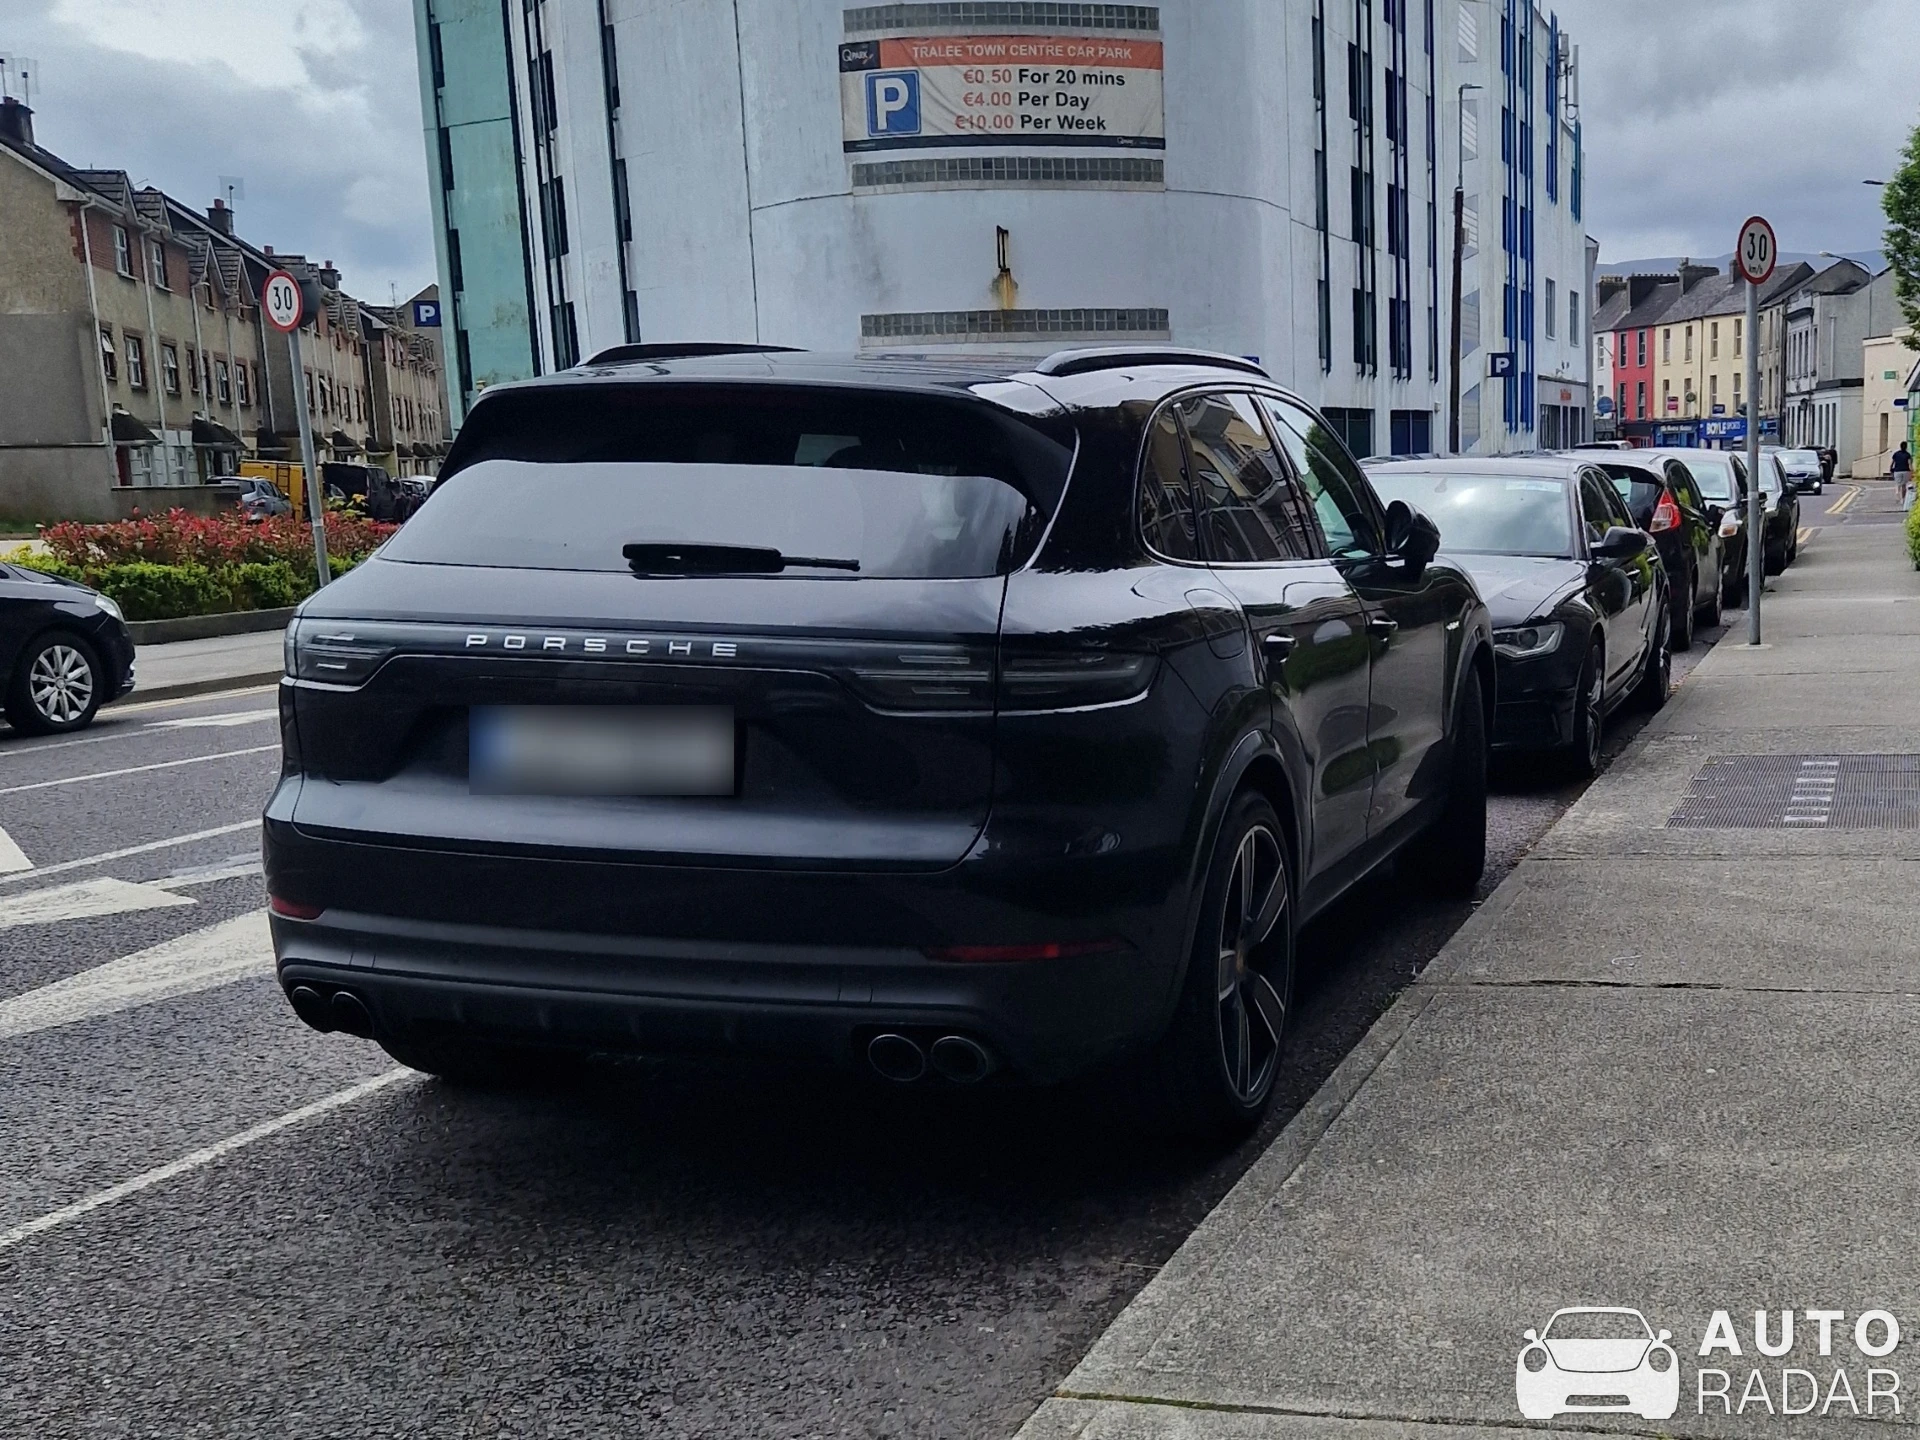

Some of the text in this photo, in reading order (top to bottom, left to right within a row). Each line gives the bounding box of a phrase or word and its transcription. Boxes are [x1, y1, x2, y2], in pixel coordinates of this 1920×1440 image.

[913, 44, 1133, 60] TRALEE TOWN CENTRE CAR PARK
[963, 68, 1126, 86] €0.50 For 20 mins
[875, 77, 909, 131] P
[963, 91, 1090, 111] €4.00 Per Day
[955, 114, 1107, 131] €10.00 Per Week
[1747, 232, 1767, 262] 30
[273, 285, 293, 311] 30
[419, 304, 436, 323] P
[1495, 357, 1510, 373] P
[465, 633, 738, 658] PORSCHE
